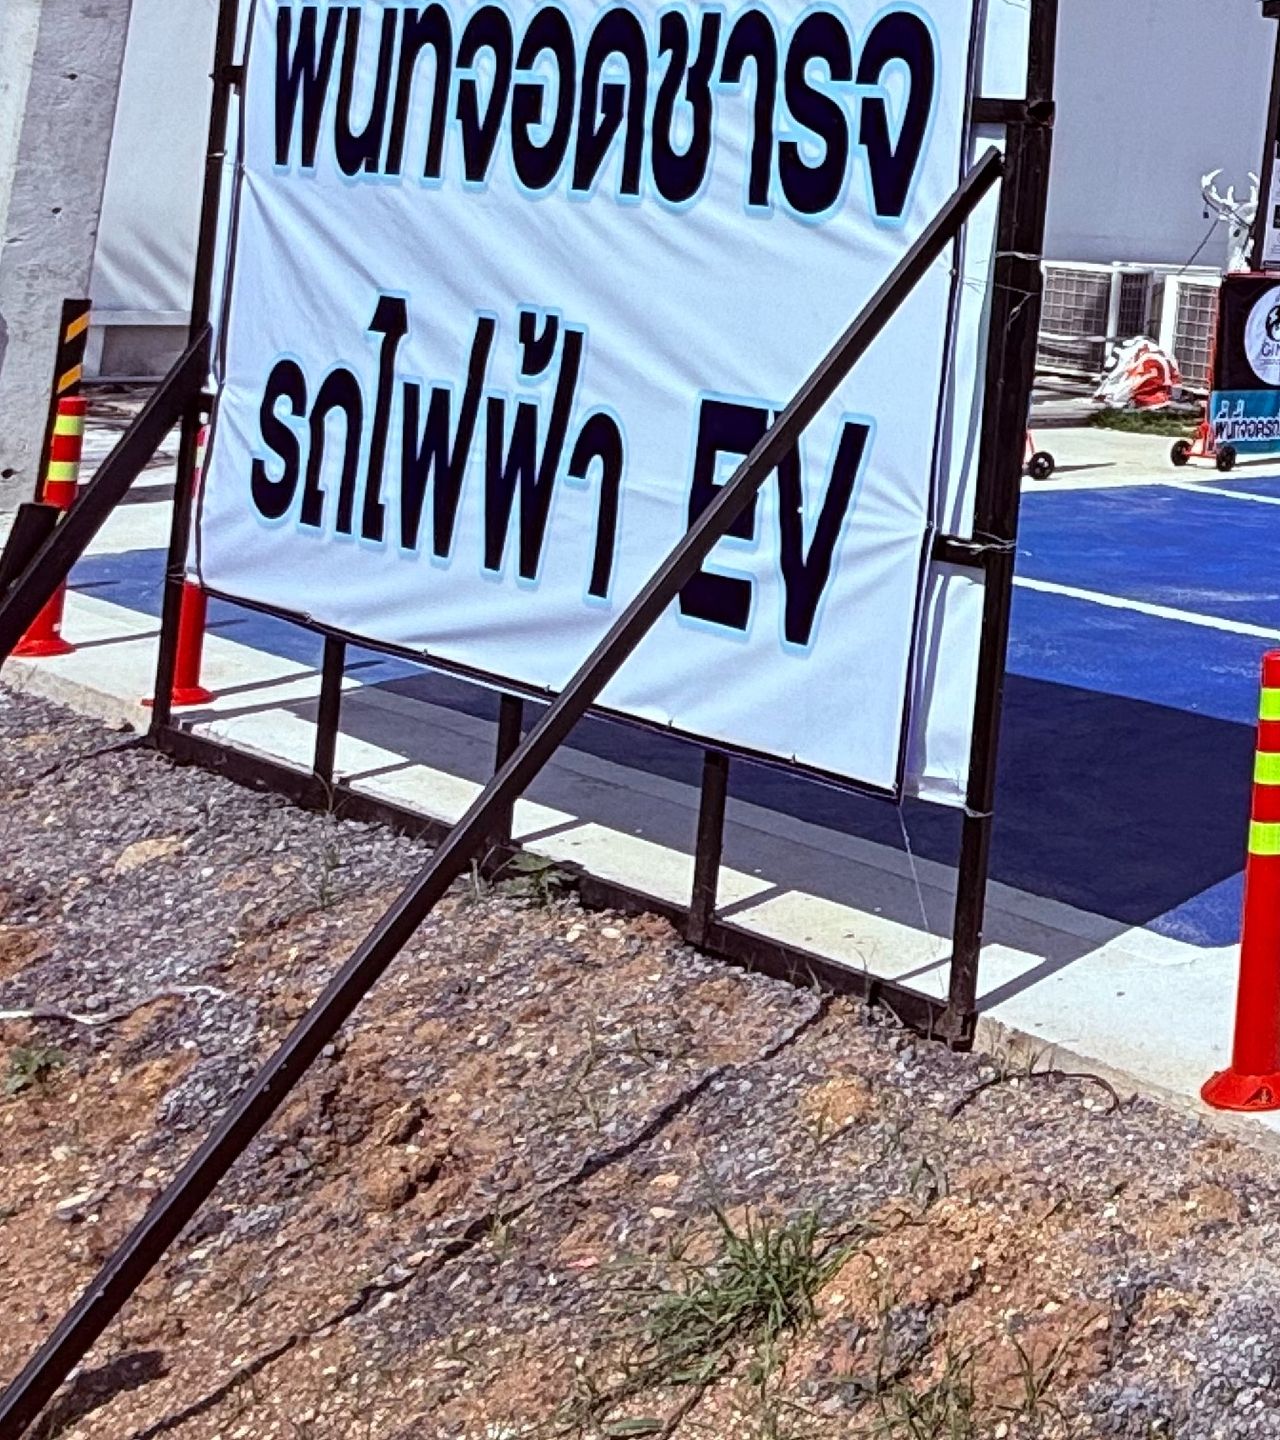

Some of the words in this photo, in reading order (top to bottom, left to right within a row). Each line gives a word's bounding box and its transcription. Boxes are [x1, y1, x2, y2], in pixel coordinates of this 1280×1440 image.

[249, 294, 625, 599] รถไฟฟ้า
[678, 396, 871, 647] EV
